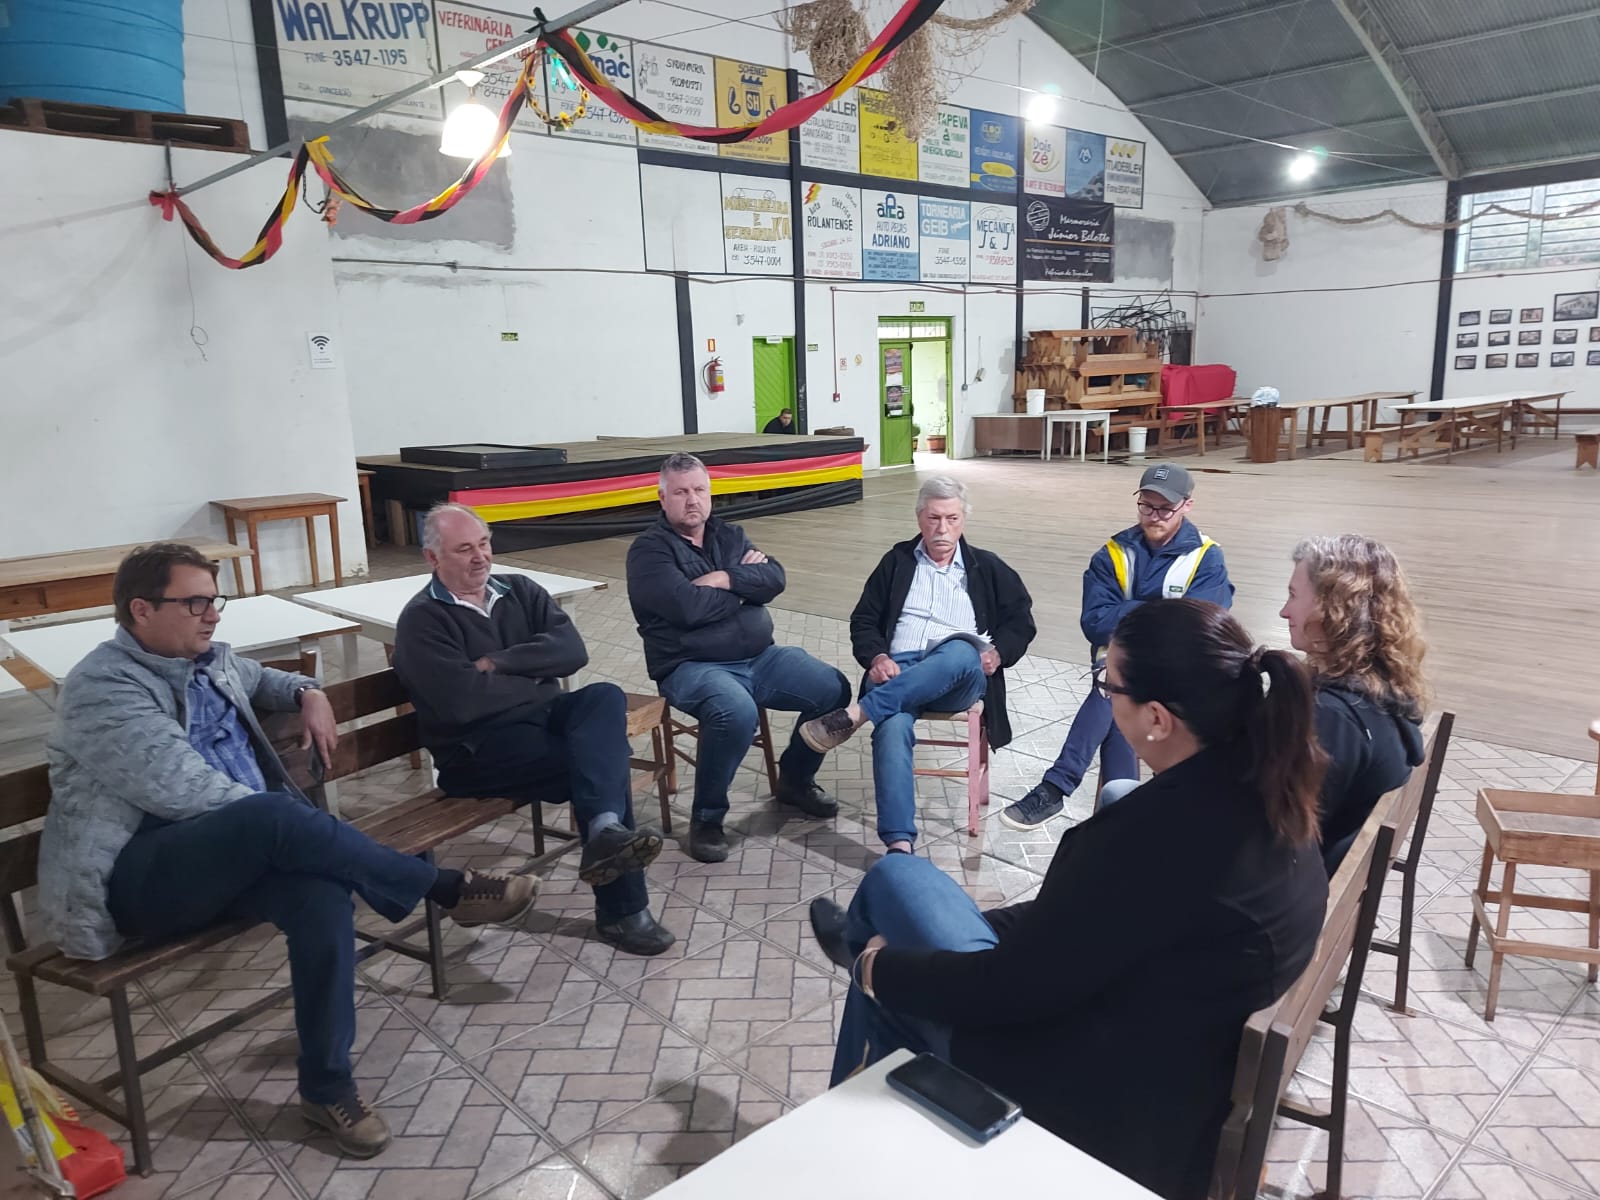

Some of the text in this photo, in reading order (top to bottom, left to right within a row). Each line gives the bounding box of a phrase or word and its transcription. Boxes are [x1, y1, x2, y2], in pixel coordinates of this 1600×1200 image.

[279, 0, 430, 41] WALKRUPP
[333, 48, 408, 67] 3547-1195
[746, 94, 760, 112] SH
[1032, 151, 1049, 166] Zé
[920, 202, 966, 220] TORNEARIA
[807, 215, 854, 231] ROLANTENSE
[921, 218, 949, 236] GEIB
[871, 233, 911, 249] ADRIANO
